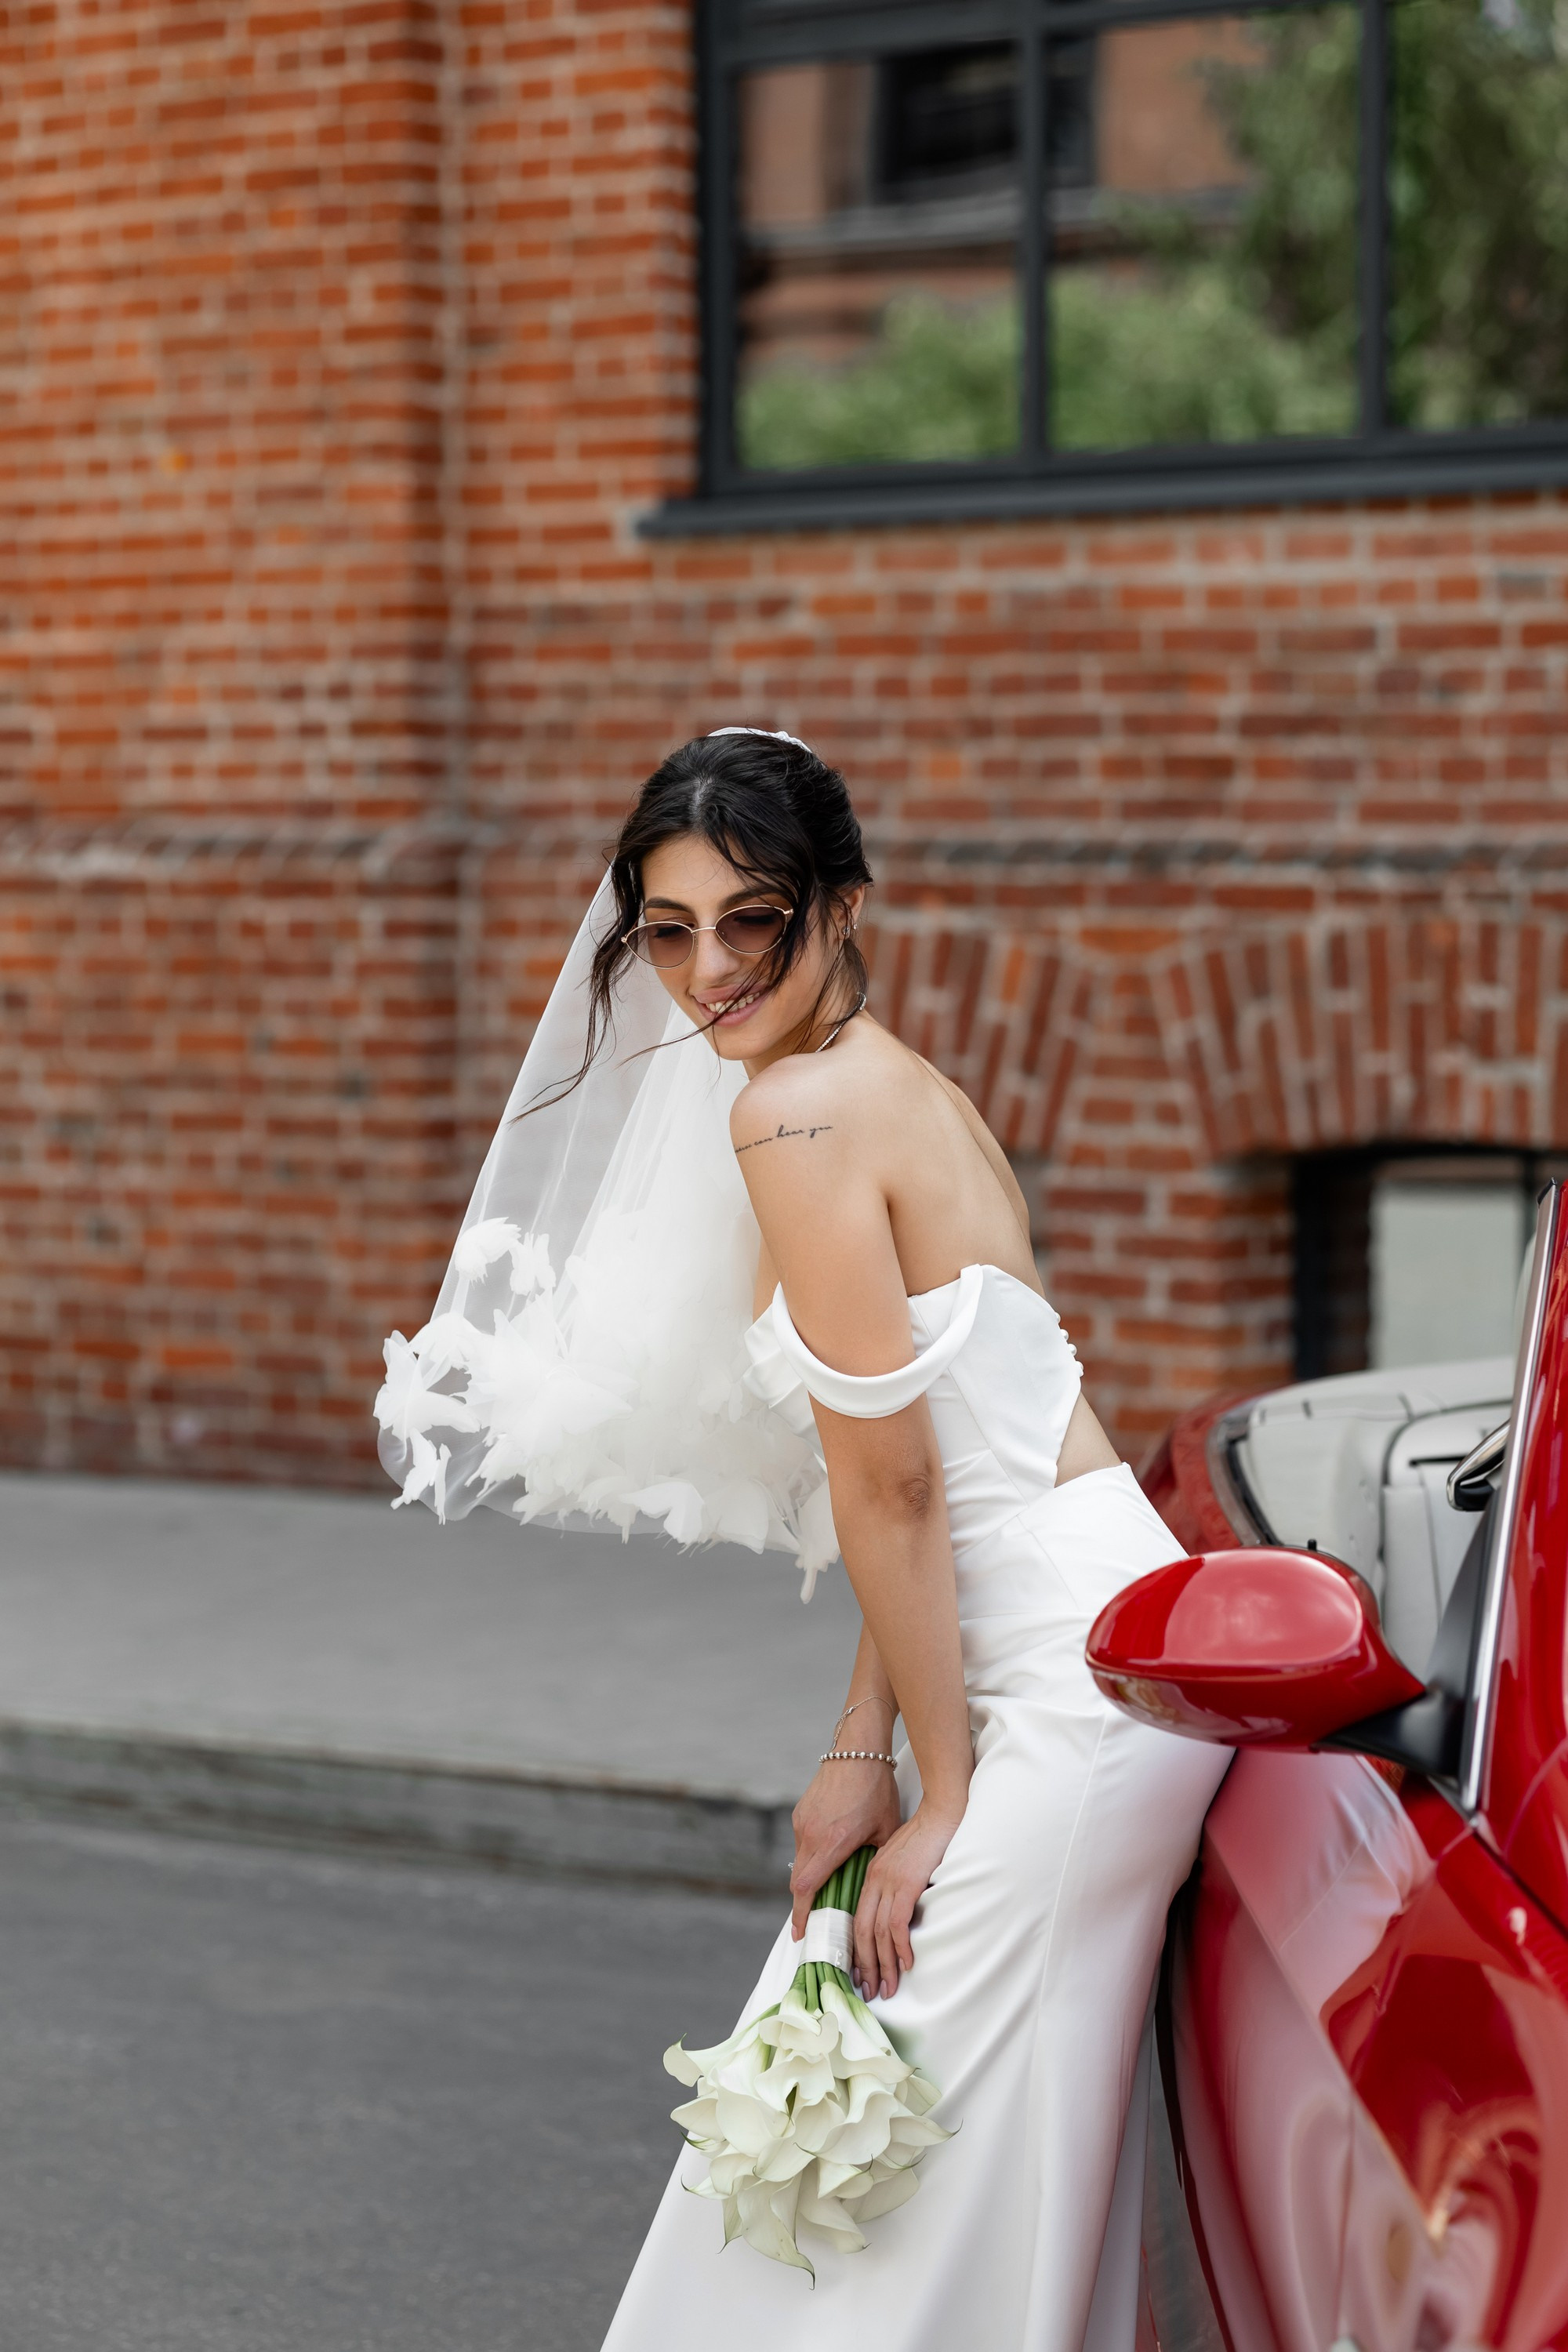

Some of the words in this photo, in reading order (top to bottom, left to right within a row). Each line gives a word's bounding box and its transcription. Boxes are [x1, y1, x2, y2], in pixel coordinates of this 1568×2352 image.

[753, 1137, 774, 1146] can
[776, 1124, 804, 1138] hear
[809, 1125, 833, 1138] you
